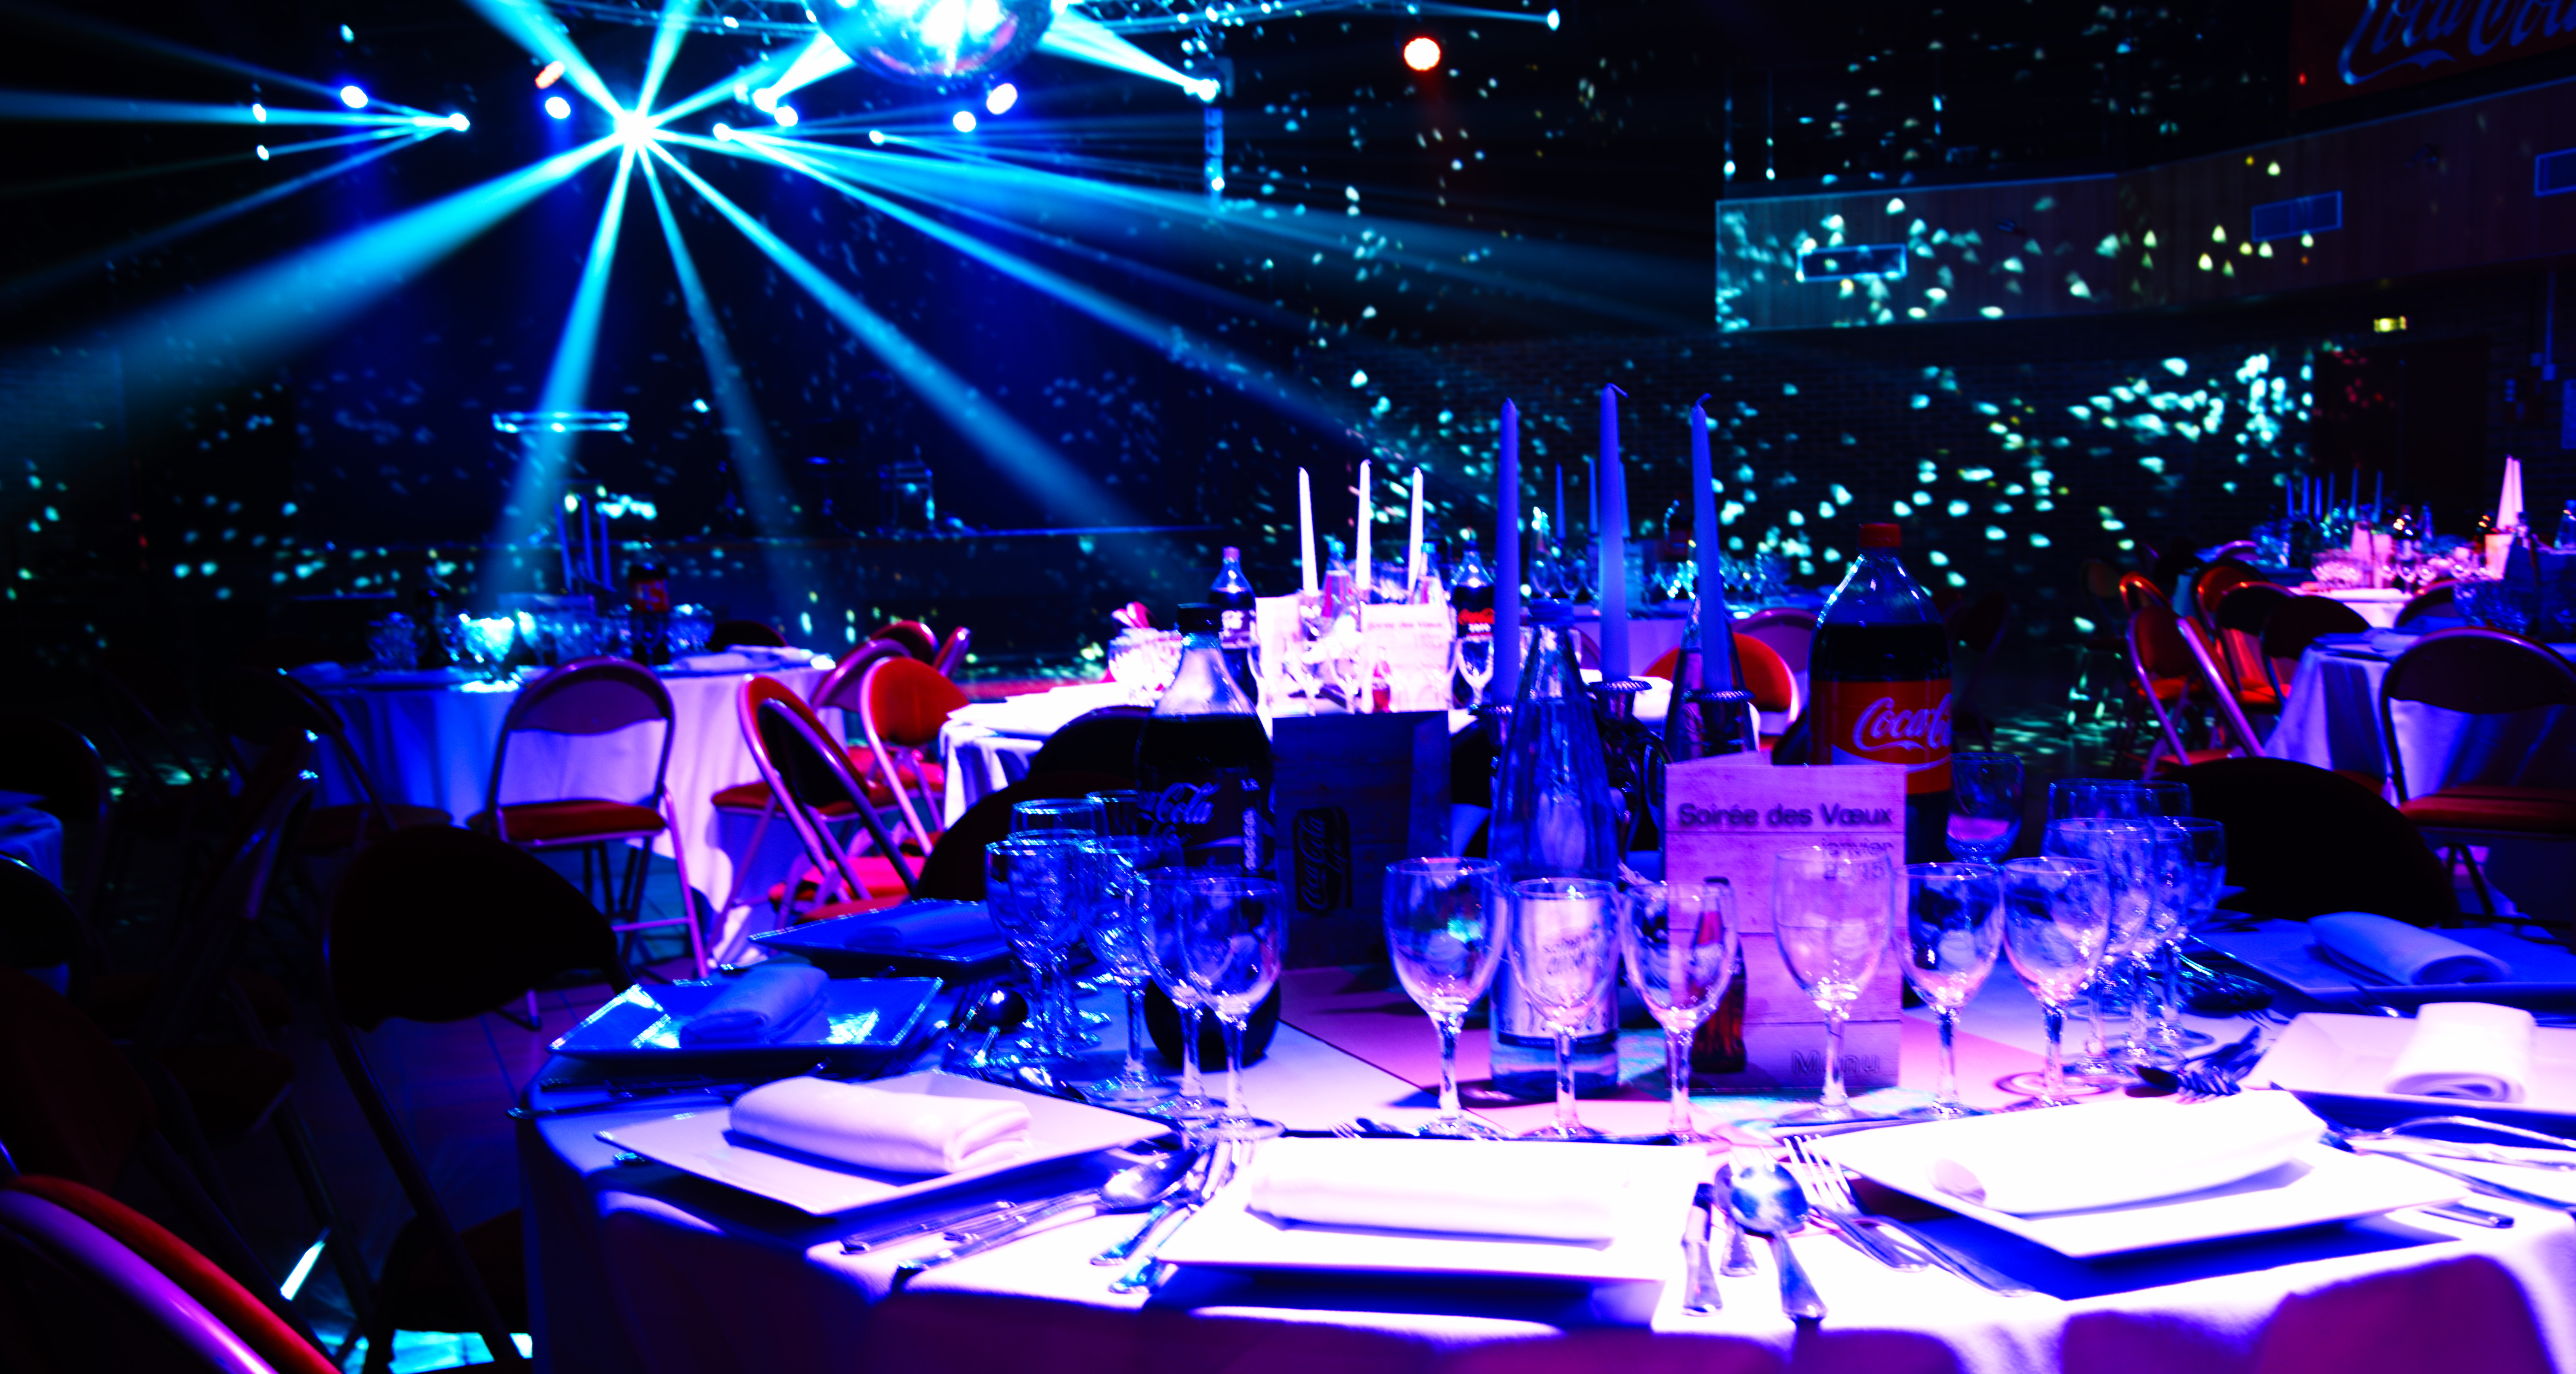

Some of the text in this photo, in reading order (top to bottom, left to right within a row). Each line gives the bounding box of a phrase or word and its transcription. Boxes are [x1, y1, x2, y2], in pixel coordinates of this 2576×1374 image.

[1679, 803, 1893, 826] Soirée des Vœux
[1821, 838, 1894, 858] janvier
[1791, 1050, 1881, 1075] Mnu
